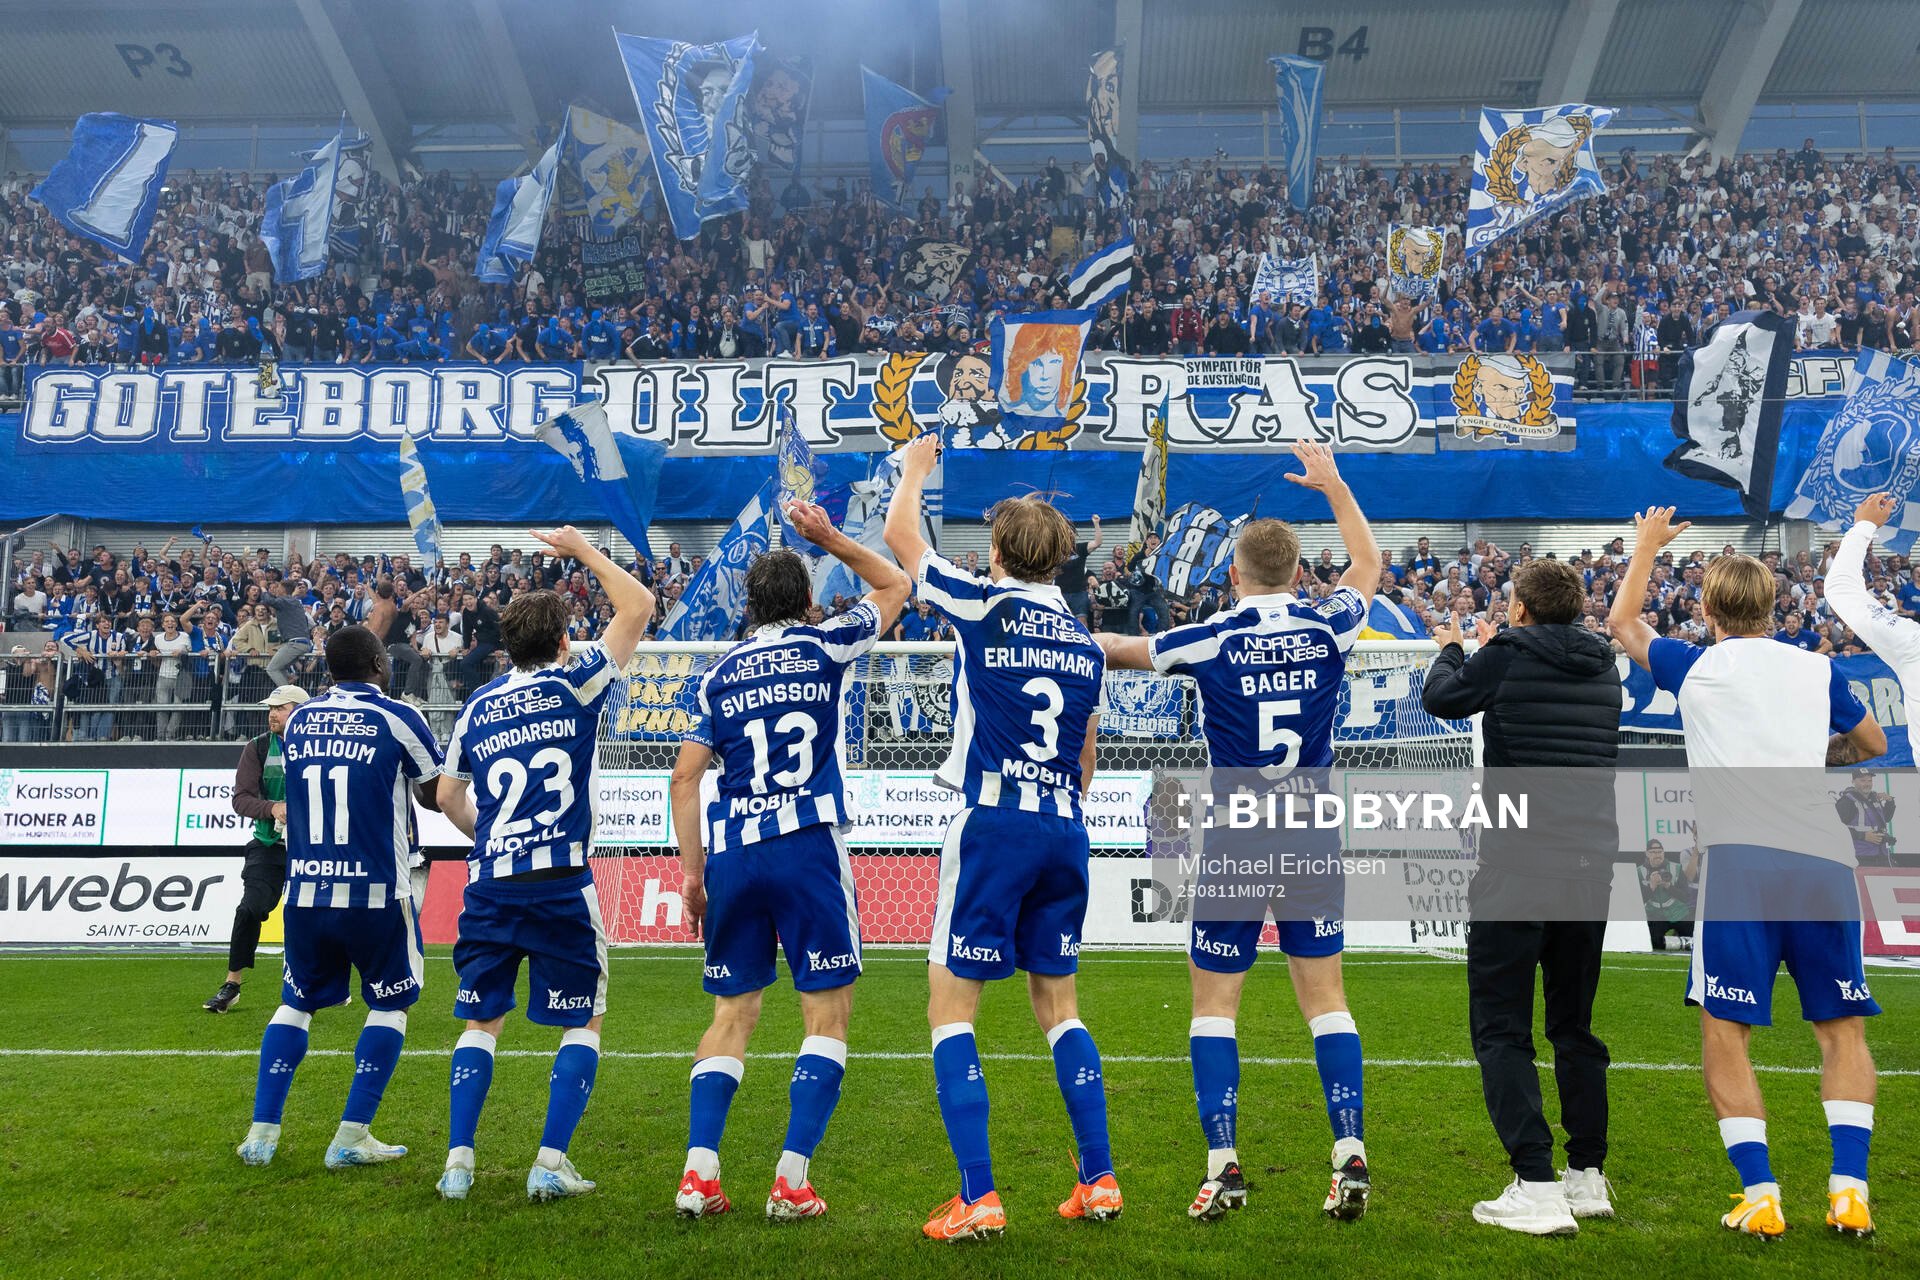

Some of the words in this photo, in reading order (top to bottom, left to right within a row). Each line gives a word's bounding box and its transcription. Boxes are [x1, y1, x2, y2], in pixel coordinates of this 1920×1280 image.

[1298, 25, 1369, 63] B4
[115, 44, 193, 78] P3
[1186, 360, 1237, 373] SYMPATI
[1240, 359, 1261, 373] FÖR
[1187, 375, 1200, 386] DE
[1202, 373, 1260, 386] AVSTÄNGDA
[1462, 417, 1491, 428] YNGRE
[1019, 607, 1075, 632] NORDIC
[1001, 618, 1091, 646] WELLNESS
[1244, 633, 1312, 650] NORDIC
[736, 648, 801, 670] NORDIC
[984, 647, 1095, 680] ERLINGMARK
[1228, 644, 1329, 665] WELLNESS
[722, 659, 820, 684] WELLNESS
[1241, 669, 1318, 696] BAGER
[485, 686, 543, 712] NORDIC
[721, 682, 832, 718] SVENSSON
[306, 711, 364, 723] NORDIC
[473, 695, 563, 727] WELLNESS
[1020, 676, 1065, 762] 3
[293, 723, 378, 737] WELLNESS
[472, 718, 577, 762] THORDARSON
[1258, 699, 1302, 780] 5
[288, 739, 376, 765] S.ALIOUM
[743, 711, 818, 795] 13
[16, 782, 98, 799] Karlsson
[486, 747, 576, 843] 23
[886, 786, 961, 802] Karlsson
[302, 764, 350, 845] 11
[4, 813, 67, 827] TIONER
[72, 813, 96, 827] AB
[640, 813, 662, 826] AB
[290, 859, 368, 877] MOBILL
[17, 862, 224, 912] weber
[86, 924, 210, 937] SAINT-GOBAIN
[951, 942, 1002, 962] RASTA
[1195, 936, 1241, 957] RASTA
[810, 953, 857, 972] RASTA
[375, 975, 417, 999] RASTA
[1706, 983, 1758, 1005] RASTA
[547, 995, 592, 1010] RASTA
